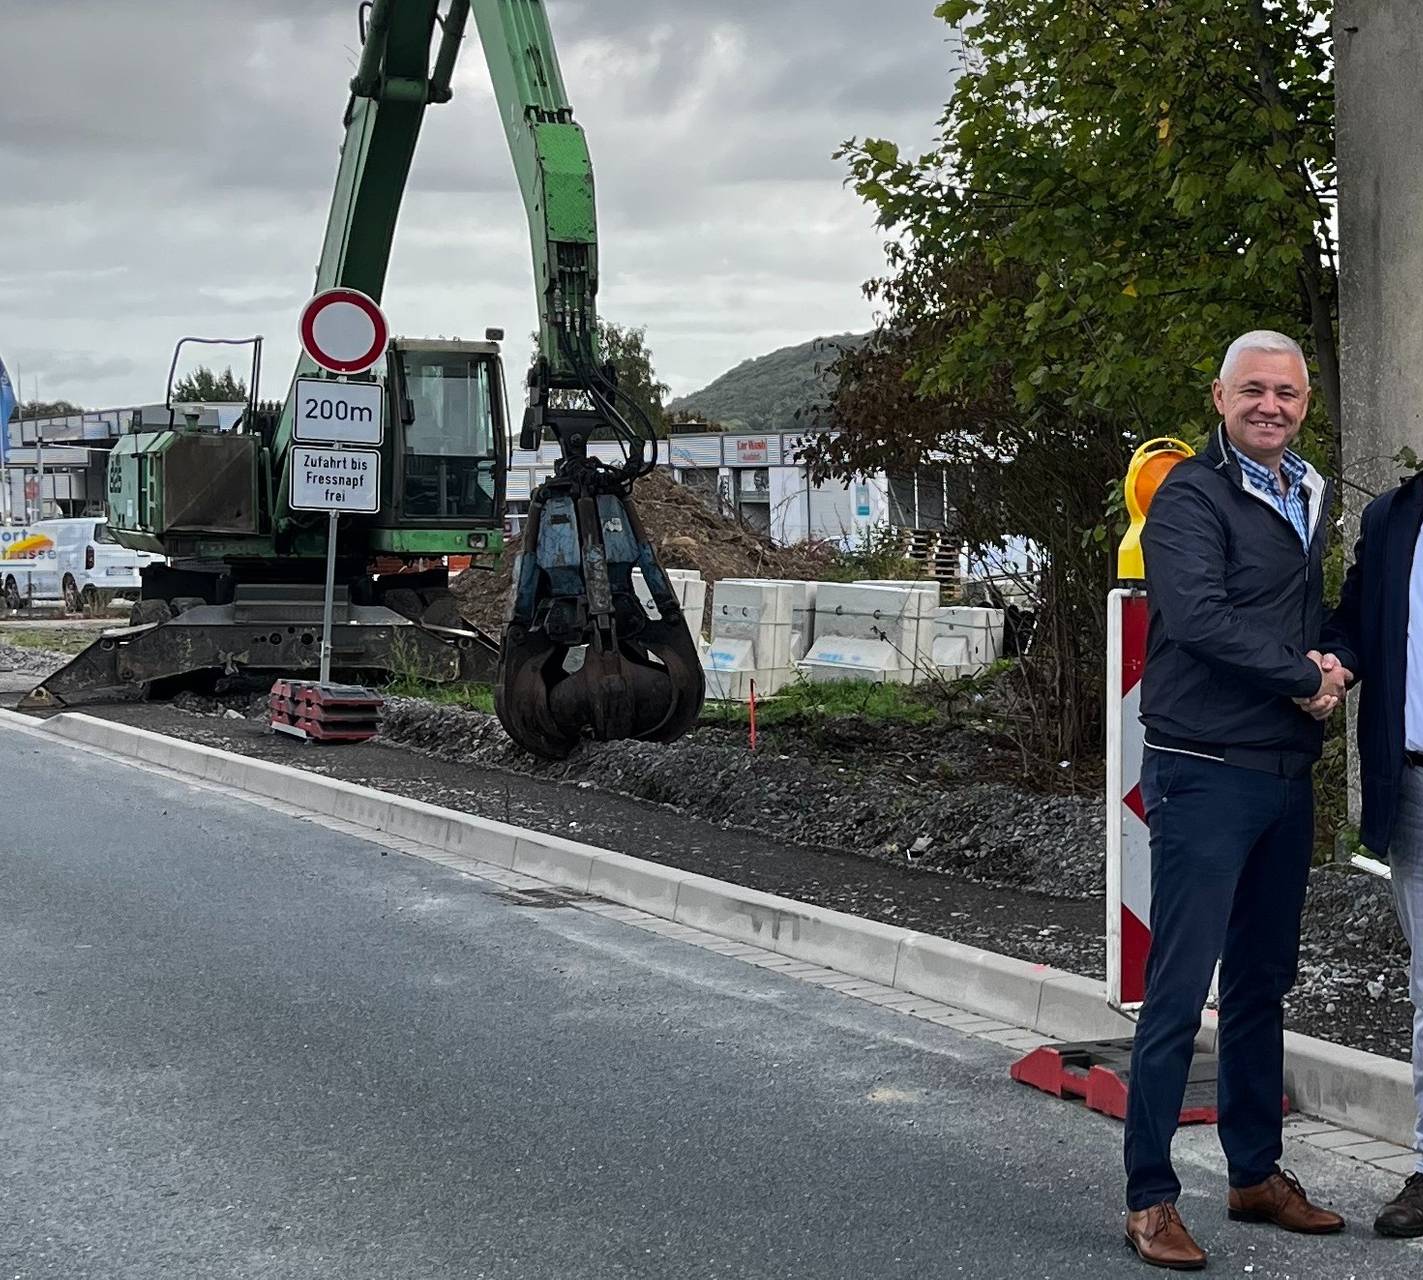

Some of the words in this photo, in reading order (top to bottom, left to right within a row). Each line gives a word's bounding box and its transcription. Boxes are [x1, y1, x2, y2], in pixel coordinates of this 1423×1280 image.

[305, 398, 372, 422] 200m
[303, 454, 347, 469] Zufahrt
[351, 457, 368, 471] bis
[306, 471, 364, 490] Fressnapf
[325, 488, 346, 502] frei
